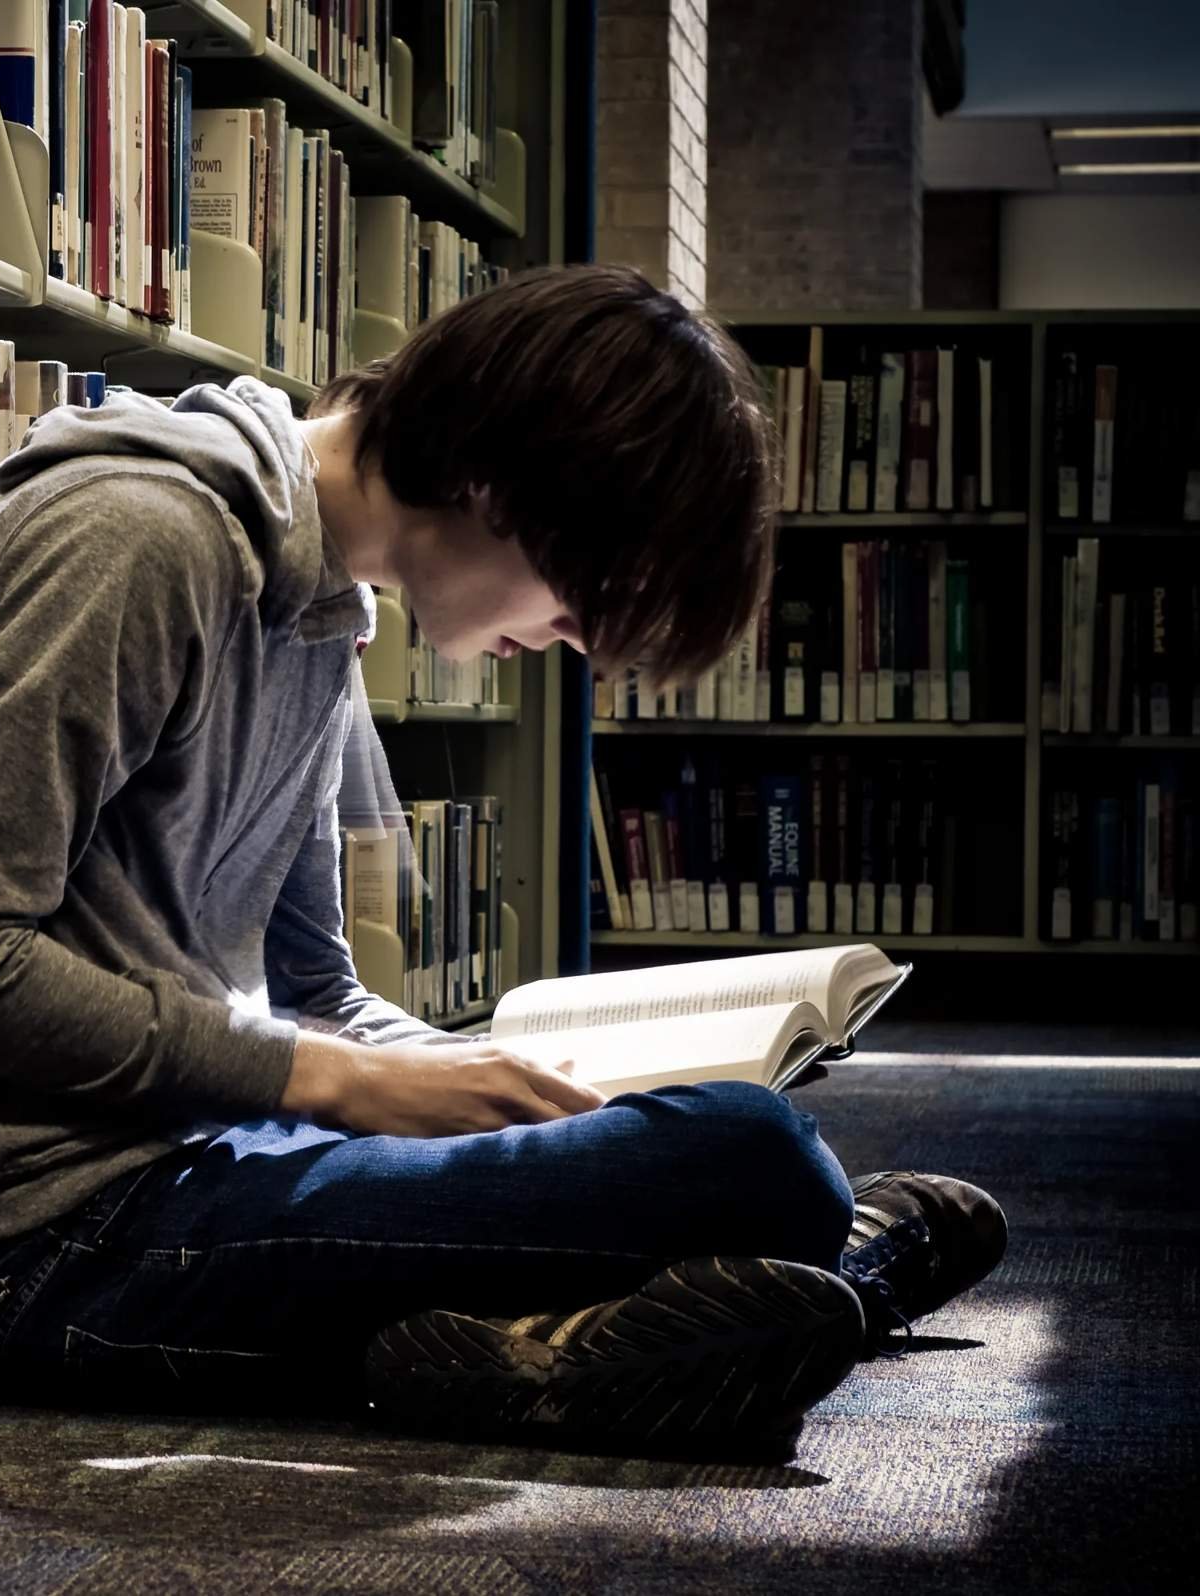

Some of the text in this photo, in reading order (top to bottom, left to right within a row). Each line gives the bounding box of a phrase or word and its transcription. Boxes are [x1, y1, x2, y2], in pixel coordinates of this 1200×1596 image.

[192, 132, 204, 152] of
[194, 176, 206, 190] Ed.
[767, 805, 783, 879] MANUAL
[784, 821, 799, 878] EQUINE
